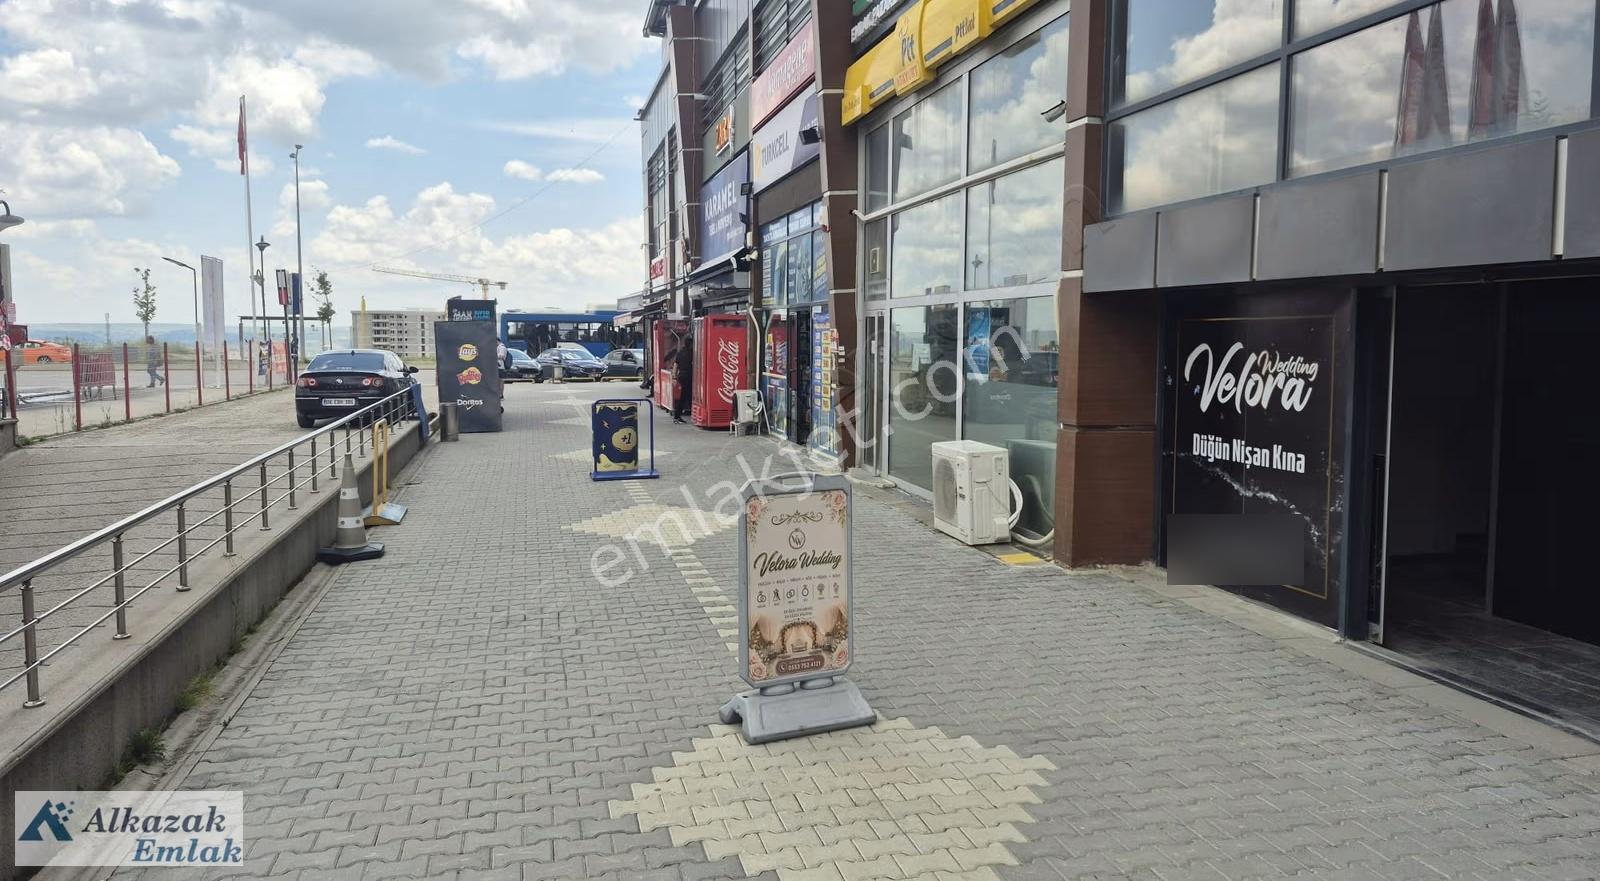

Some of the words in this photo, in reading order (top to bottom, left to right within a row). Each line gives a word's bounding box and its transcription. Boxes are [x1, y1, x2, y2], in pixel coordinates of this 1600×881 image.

[704, 181, 737, 222] KARAMEL
[1184, 341, 1313, 414] Velora
[1257, 350, 1319, 382] Wedding
[1192, 433, 1230, 462] Düğün
[1232, 438, 1270, 469] Nişan
[1272, 443, 1306, 474] Kına
[753, 550, 799, 577] Velora
[798, 549, 842, 570] Wedding
